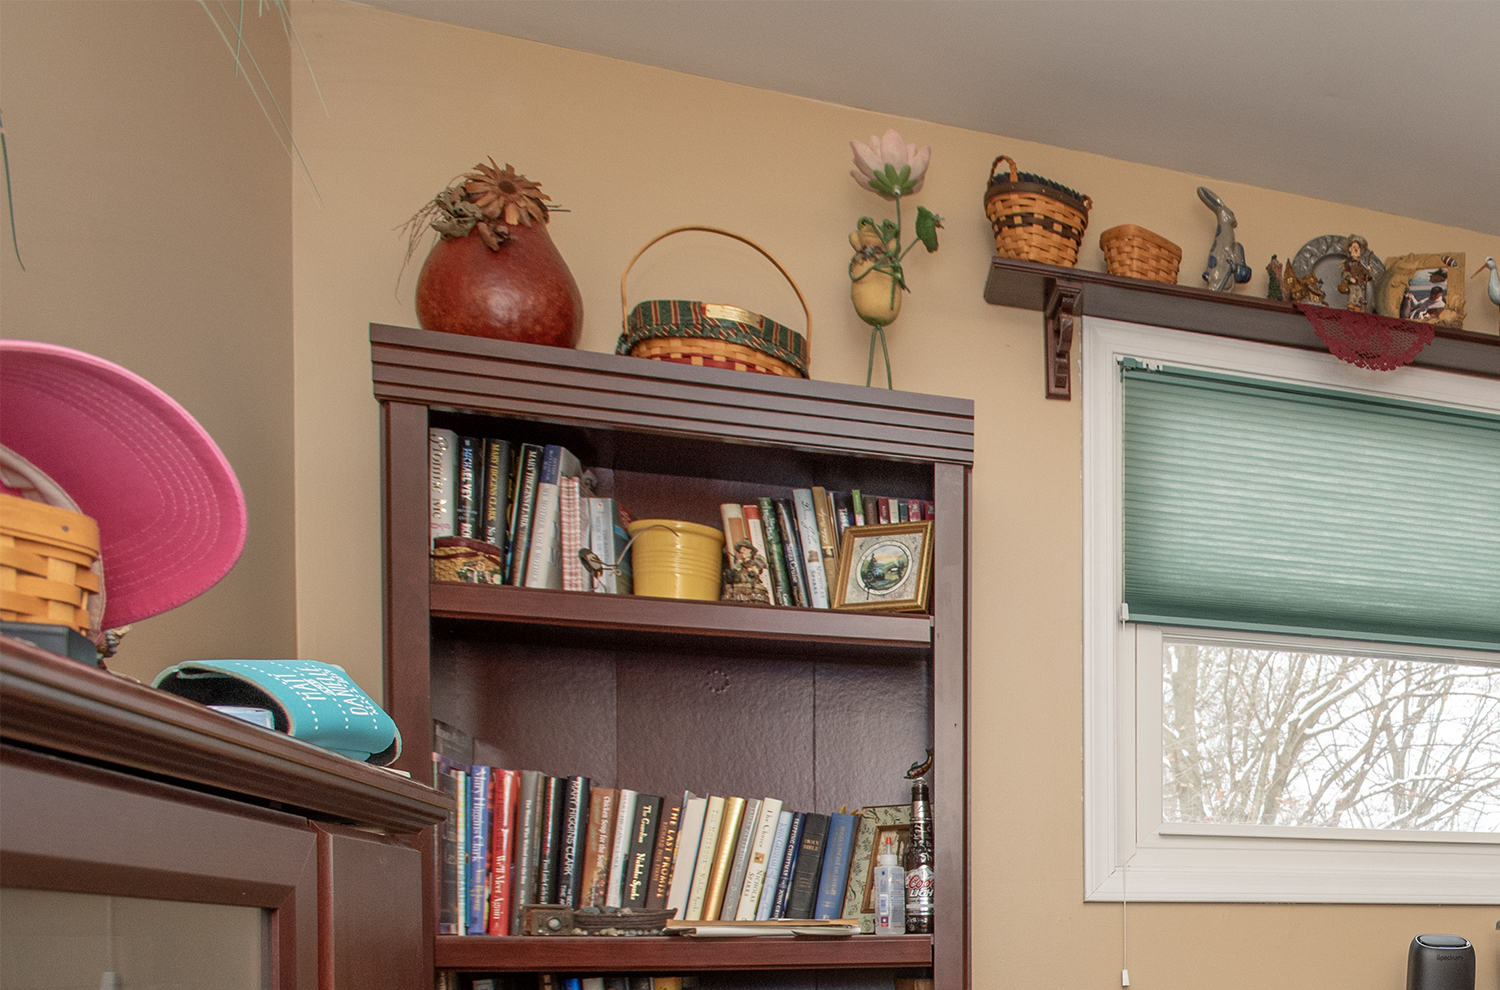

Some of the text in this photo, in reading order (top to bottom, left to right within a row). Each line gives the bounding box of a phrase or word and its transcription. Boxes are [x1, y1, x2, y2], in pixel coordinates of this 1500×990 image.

[430, 434, 451, 493] Promise
[461, 448, 472, 501] MICHAEL VEY
[527, 451, 537, 471] MARY
[488, 443, 499, 521] MARY HIGGINS CLARK
[523, 472, 535, 501] HIGGINS
[520, 502, 531, 527] CLARK
[790, 561, 799, 583] Cruise
[810, 570, 818, 594] SPARKS
[816, 565, 826, 599] NICHOLAS
[471, 768, 486, 862] Mary Higgins Clark
[602, 796, 610, 818] Chicken
[563, 780, 579, 876] MARY HIGGINS CLARK
[599, 820, 608, 833] Soup
[599, 835, 608, 843] for
[759, 810, 773, 848] The Choice
[629, 805, 652, 900] The Guardian Nicholas Sparks
[656, 807, 680, 898] THE LAST PROMISE
[771, 823, 787, 868] JOHN GRISHAM
[494, 875, 505, 893] Meet
[743, 872, 754, 897] SPARKS
[750, 870, 763, 902] NICHOLAS
[492, 896, 503, 919] Again
